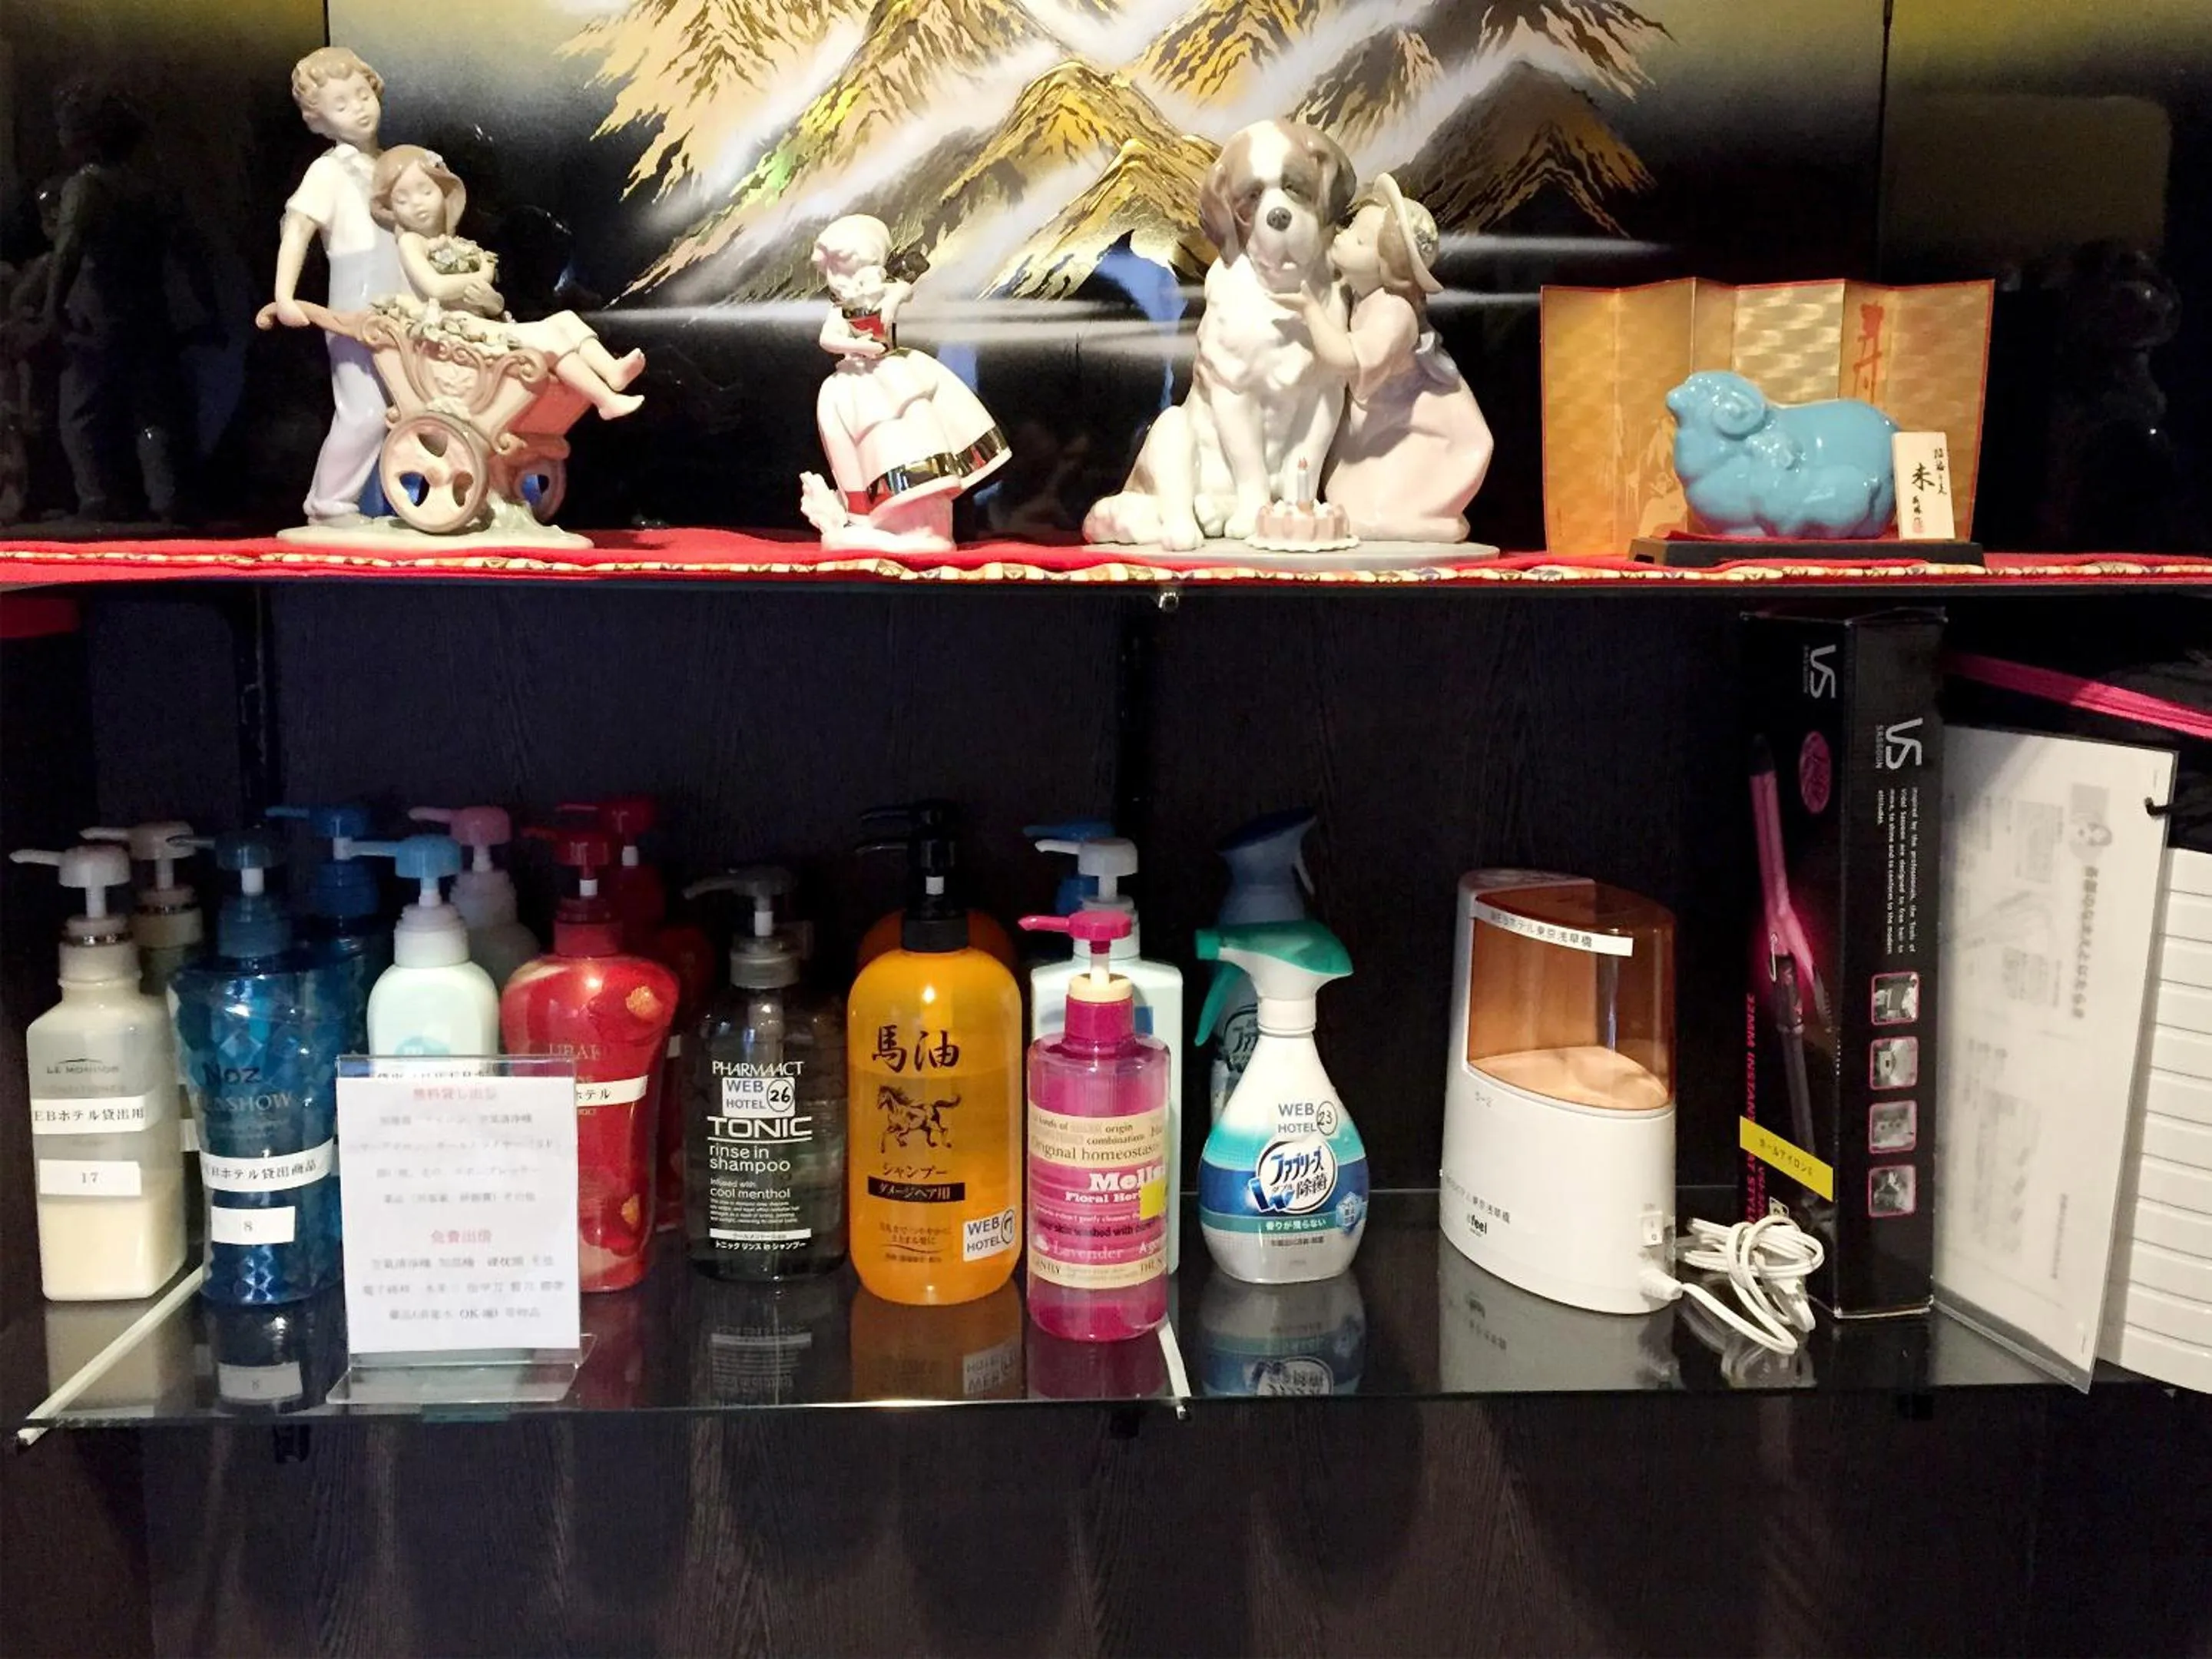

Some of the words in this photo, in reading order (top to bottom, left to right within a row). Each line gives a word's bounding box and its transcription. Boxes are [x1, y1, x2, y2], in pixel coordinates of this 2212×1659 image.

[872, 1025, 961, 1073] 馬油
[726, 1080, 764, 1093] WEB
[769, 1086, 792, 1104] 26
[726, 1098, 767, 1110] HOTEL
[1278, 1103, 1315, 1115] WEB
[1317, 1111, 1333, 1126] 23
[707, 1116, 813, 1138] TONIC
[1278, 1122, 1317, 1134] HOTEL
[709, 1144, 750, 1159] rinse
[753, 1144, 770, 1159] in
[709, 1157, 791, 1174] shampoo
[882, 1162, 948, 1181] シャンプー
[1270, 1147, 1323, 1186] ファブリーズ
[80, 1171, 99, 1184] 17
[710, 1188, 735, 1198] cool
[737, 1188, 791, 1199] menthol
[1296, 1174, 1327, 1199] 除菌
[1065, 1191, 1108, 1204] Floral
[1114, 1191, 1141, 1203] Her
[244, 1220, 253, 1232] 8
[967, 1216, 1000, 1236] WEB
[1113, 1225, 1134, 1236] with
[966, 1233, 1003, 1253] HOTEL
